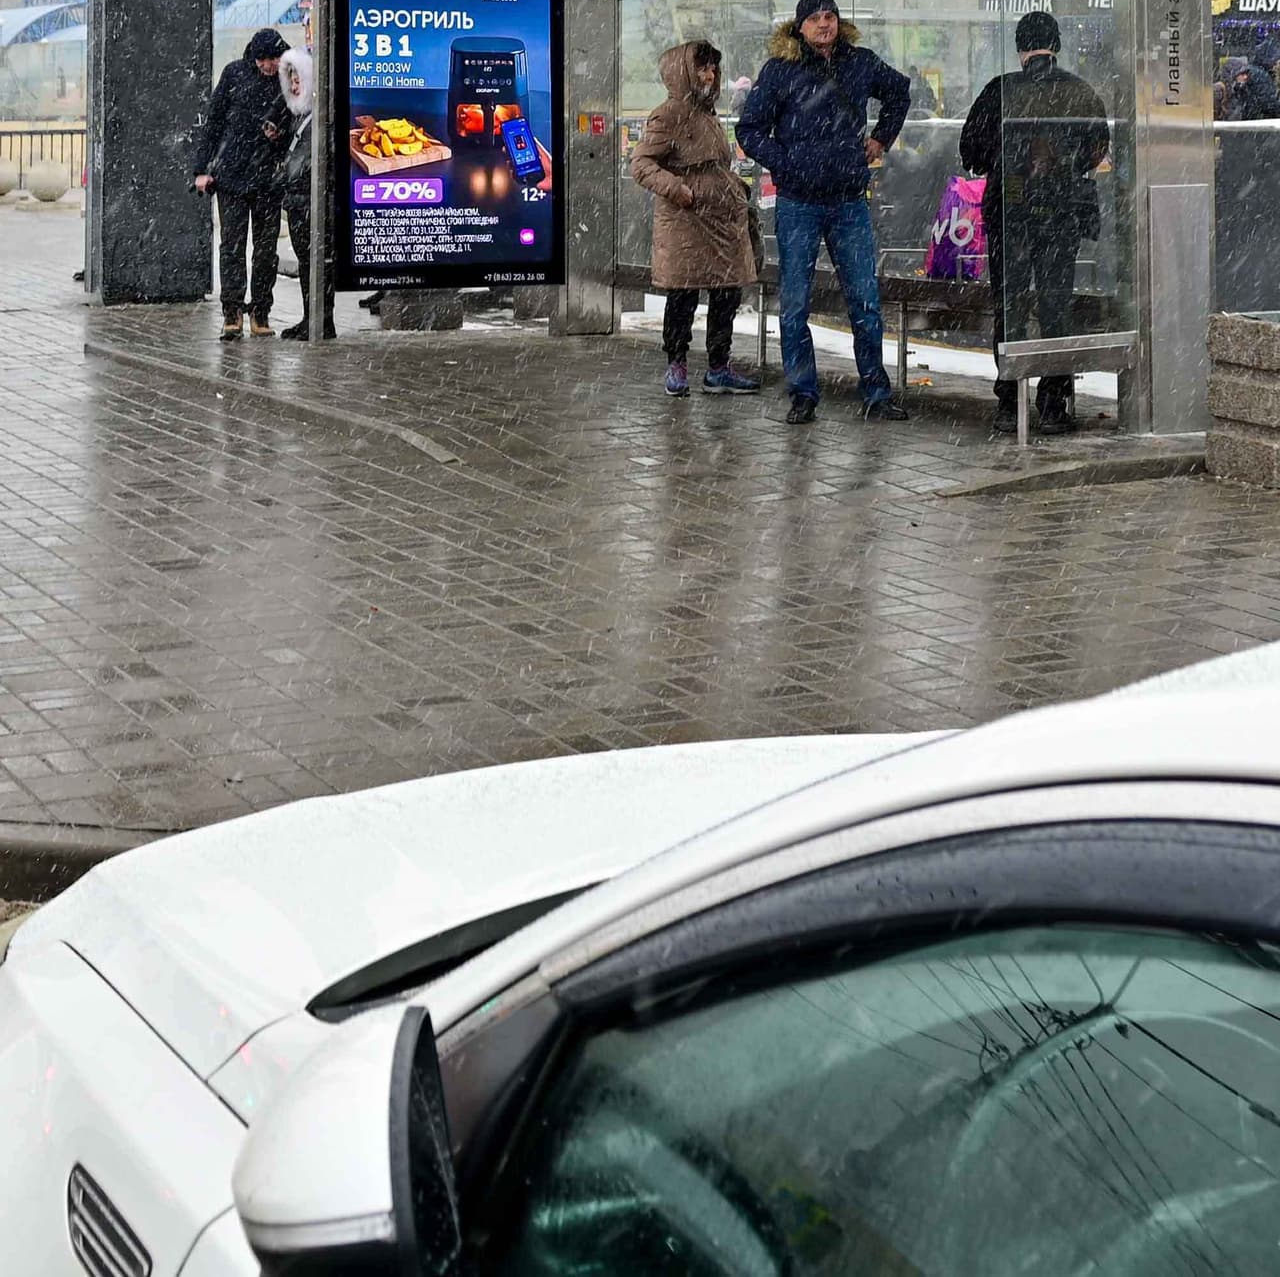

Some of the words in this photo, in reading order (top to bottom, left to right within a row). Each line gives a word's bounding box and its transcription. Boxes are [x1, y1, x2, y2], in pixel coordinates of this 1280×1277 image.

[353, 9, 474, 29] АЭРОГРИЛЬ
[354, 34, 369, 57] 3
[376, 34, 392, 57] В
[398, 34, 413, 57] 1
[1165, 8, 1180, 106] Главный
[354, 62, 373, 73] PAF
[375, 62, 411, 73] 8003W
[354, 76, 382, 86] Wi-Fi
[382, 76, 393, 87] IQ
[396, 77, 425, 87] Home
[521, 187, 547, 202] 12+
